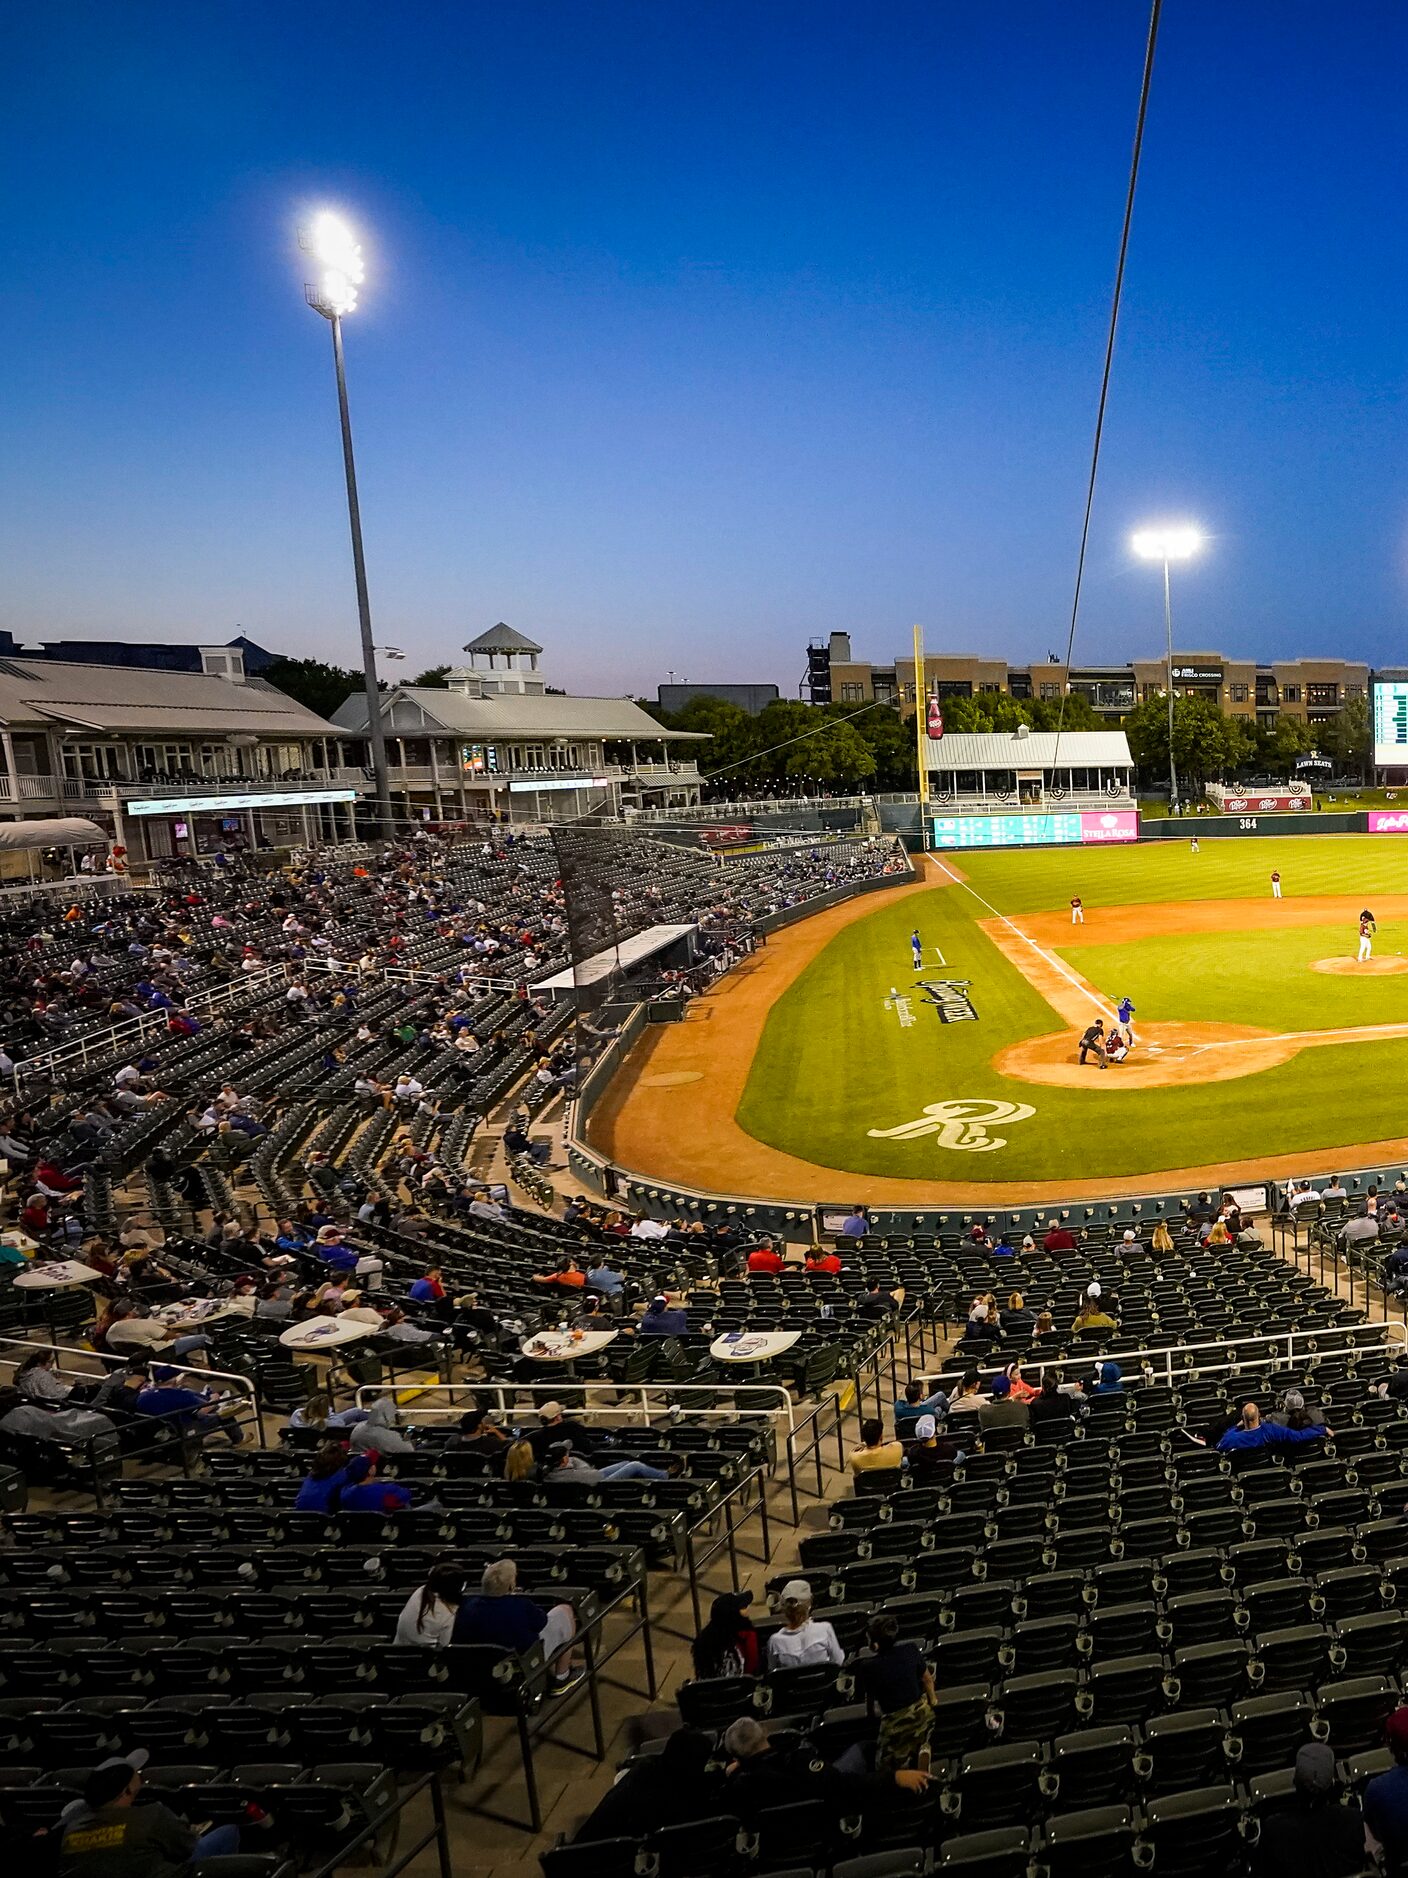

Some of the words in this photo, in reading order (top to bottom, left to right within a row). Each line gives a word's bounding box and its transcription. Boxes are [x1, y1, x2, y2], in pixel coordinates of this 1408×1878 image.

[1296, 760, 1313, 769] LAWN
[1313, 760, 1332, 769] SEATS
[1239, 818, 1257, 829] 364
